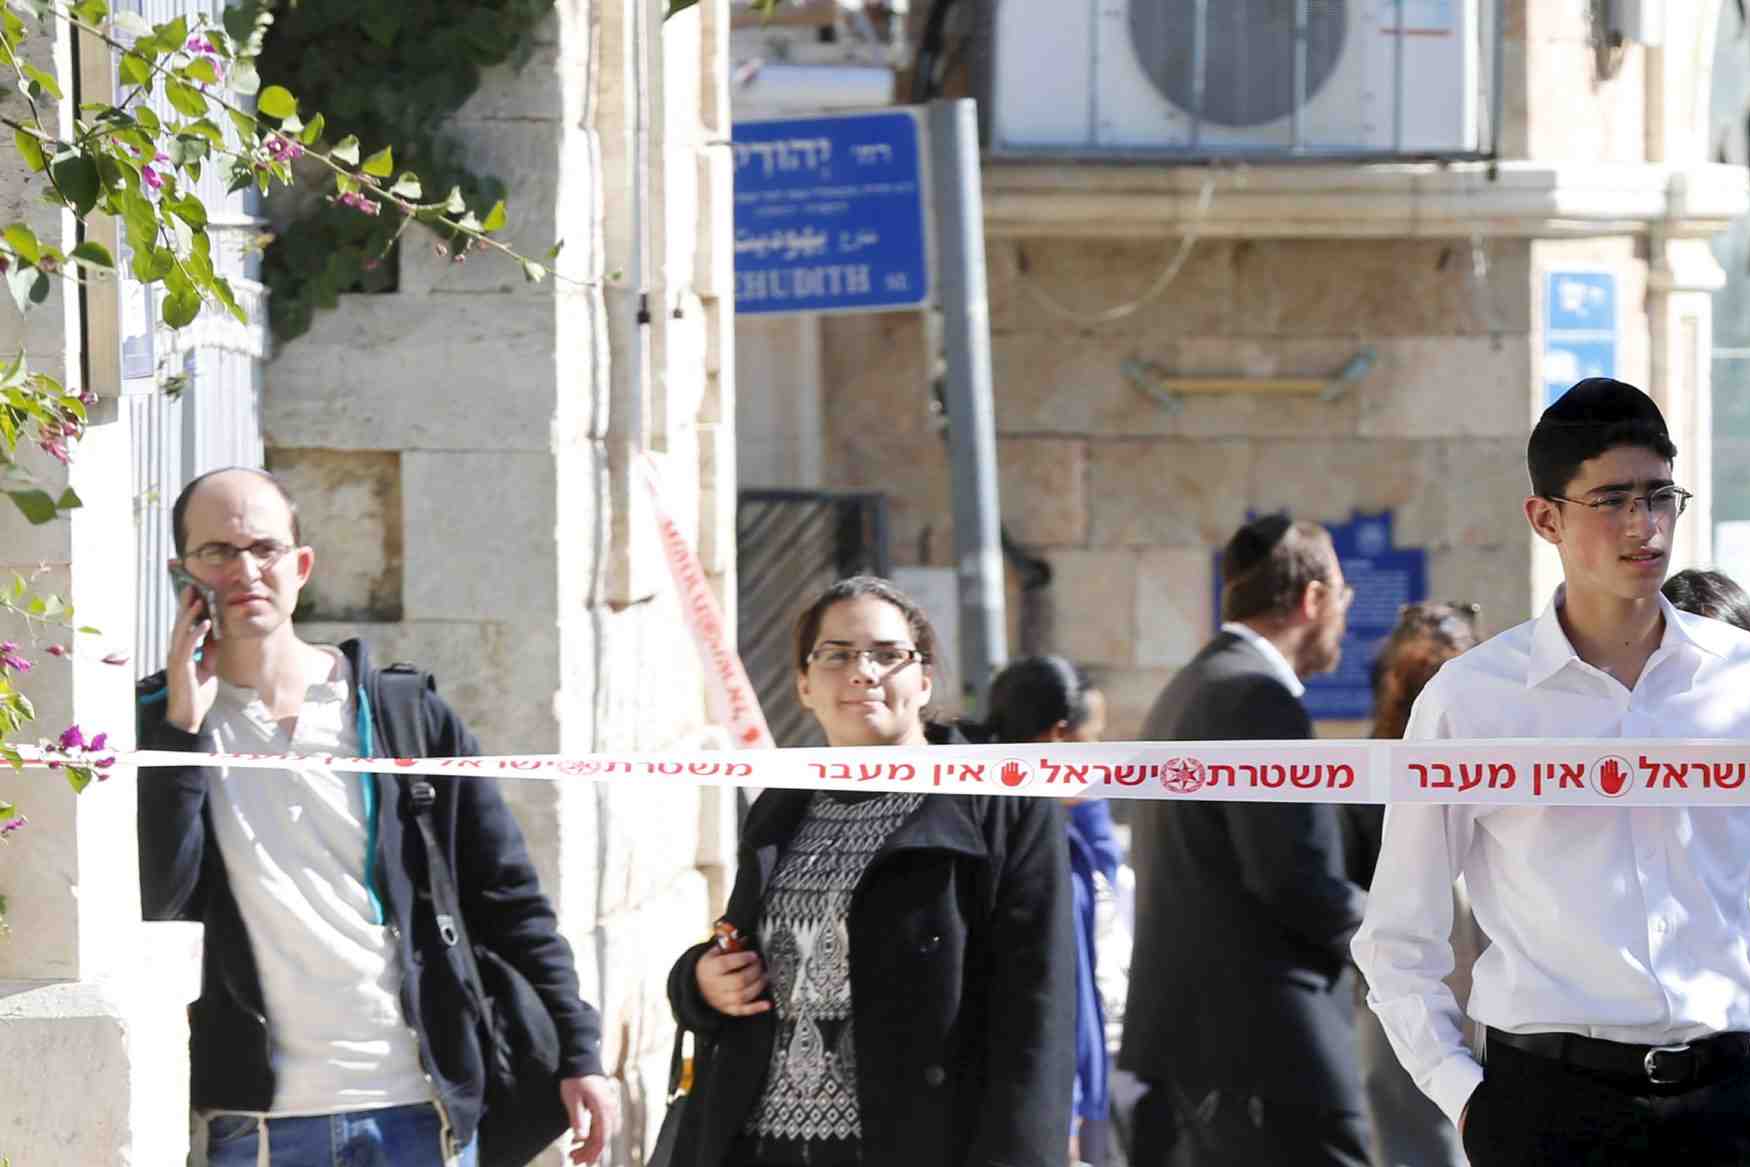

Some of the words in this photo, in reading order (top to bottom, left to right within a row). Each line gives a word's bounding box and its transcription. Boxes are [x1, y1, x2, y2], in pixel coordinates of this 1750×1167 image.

[603, 760, 754, 777] משטרת
[807, 762, 916, 782] מעבר
[932, 763, 986, 787] אין
[1039, 758, 1159, 786] ישראל
[1205, 762, 1356, 789] משטרת
[1407, 762, 1518, 793] מעבר
[1532, 762, 1586, 797] אין
